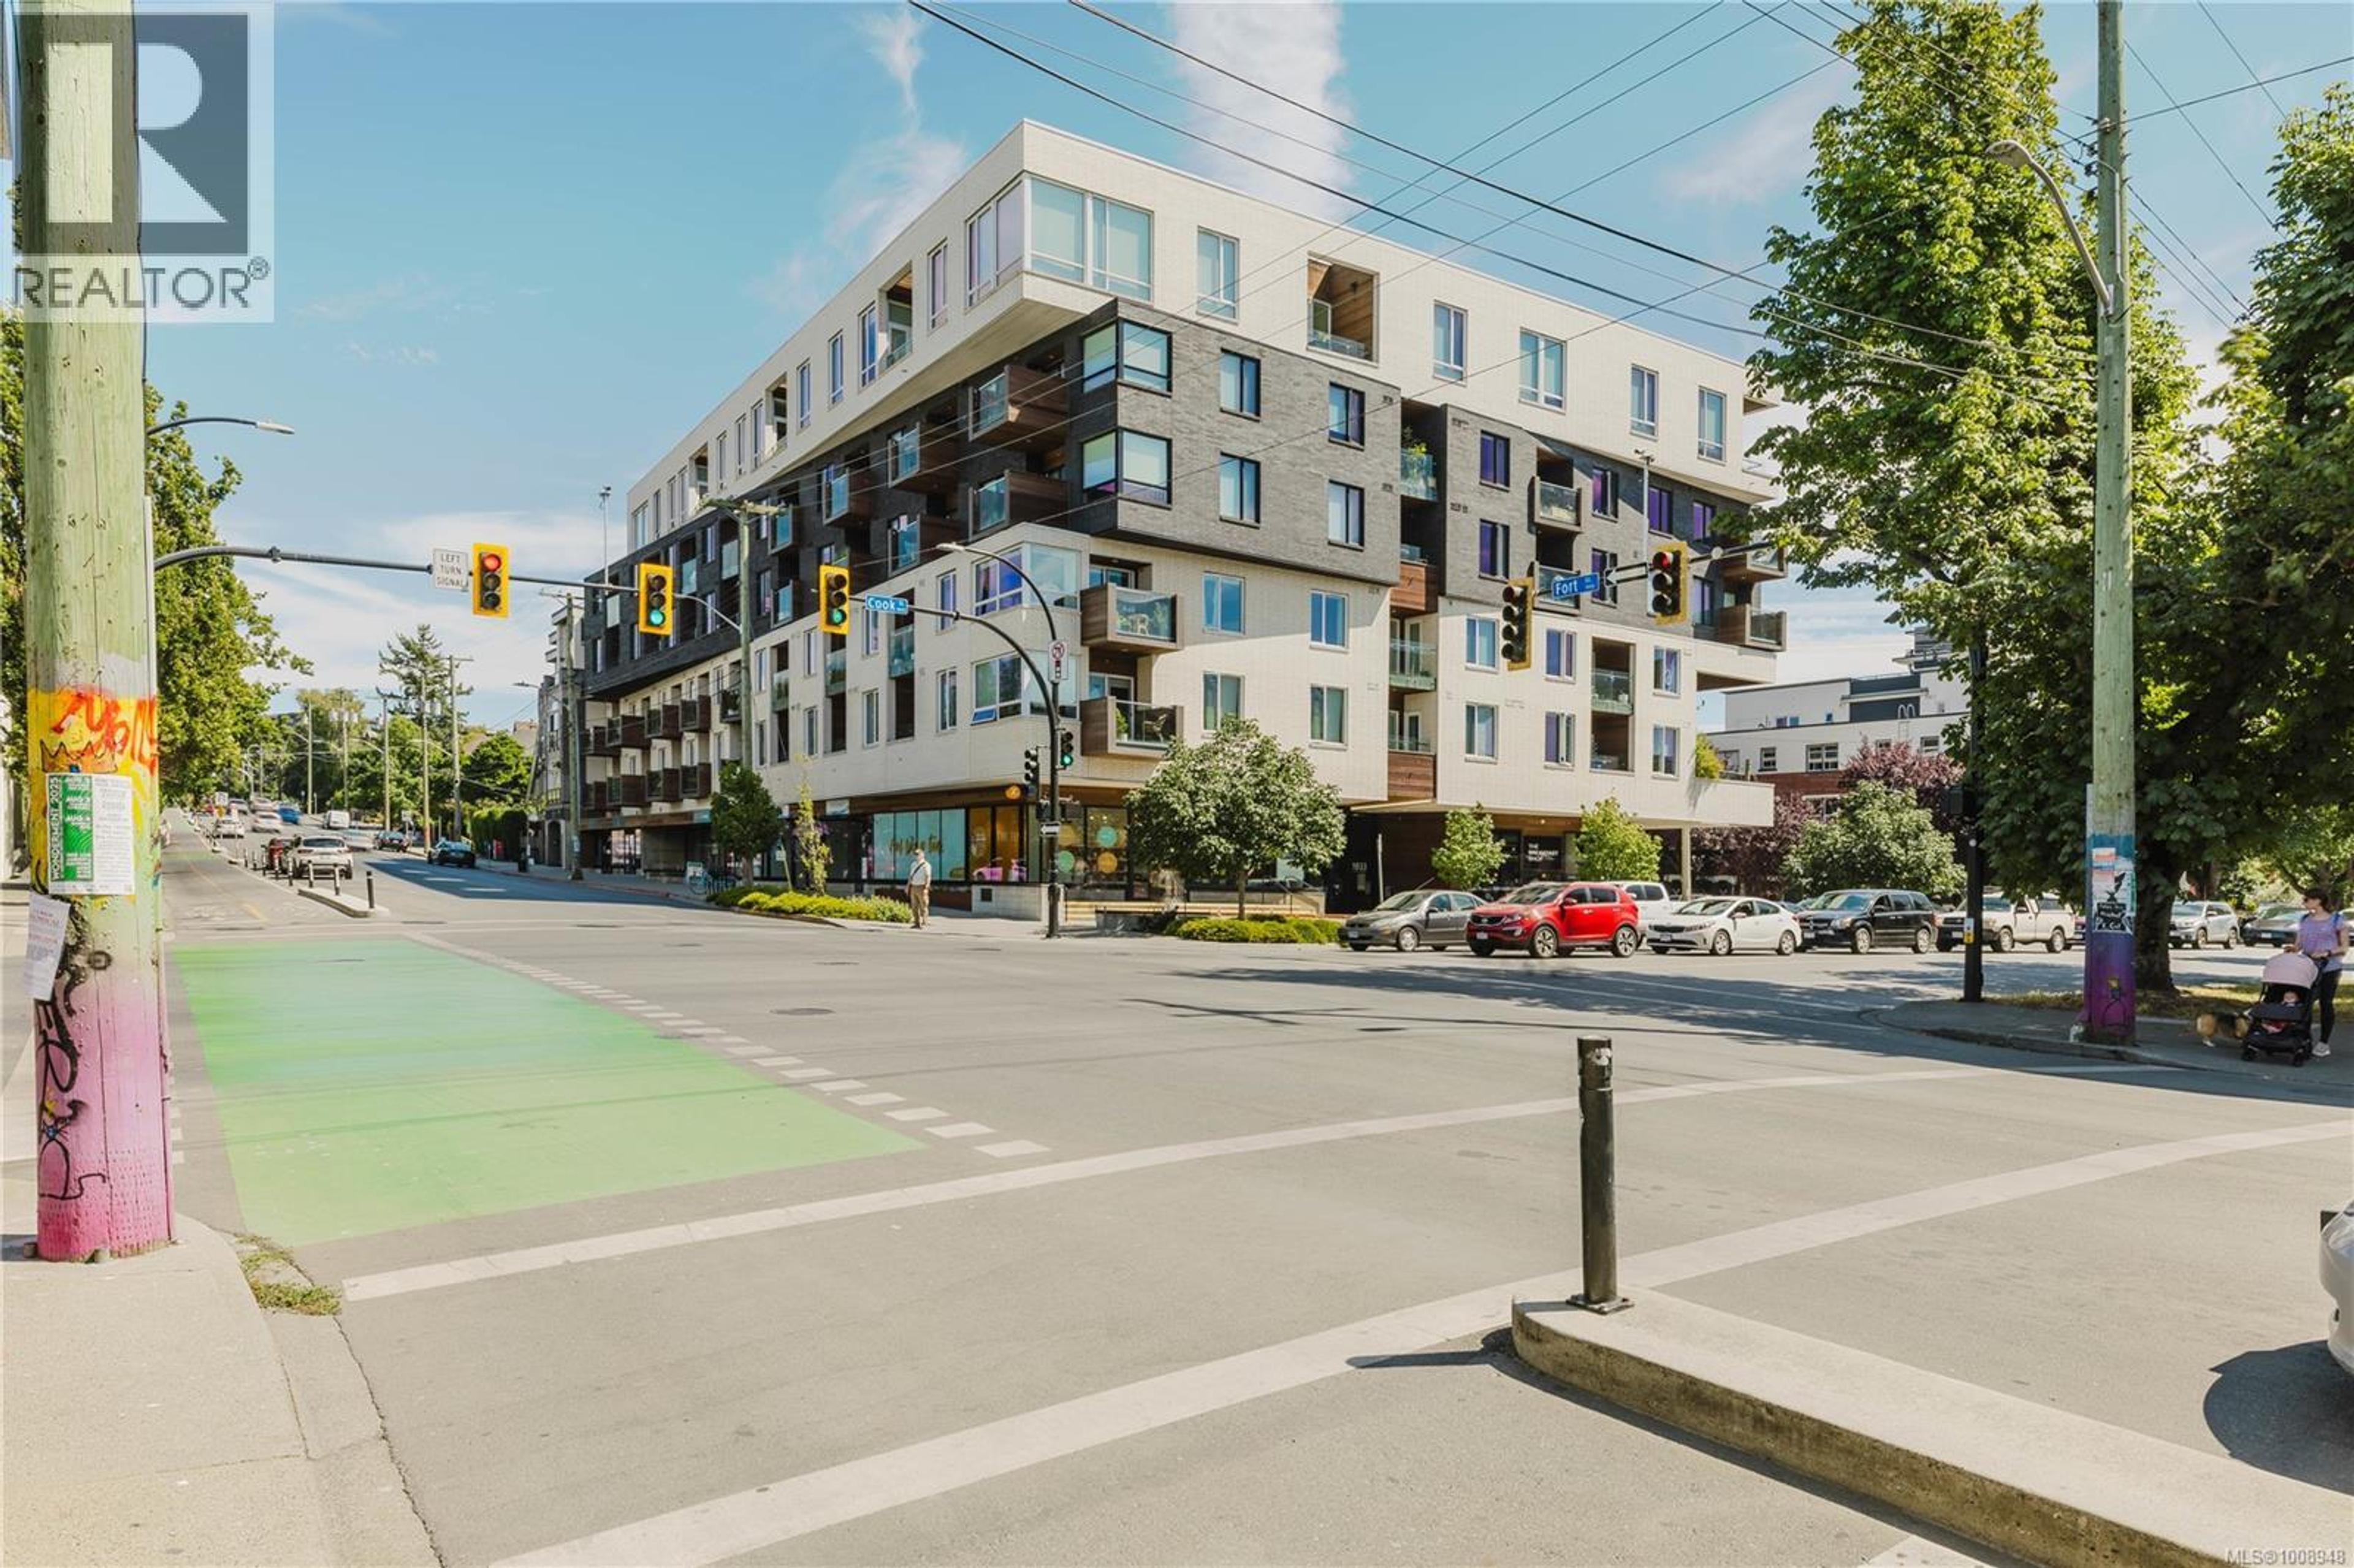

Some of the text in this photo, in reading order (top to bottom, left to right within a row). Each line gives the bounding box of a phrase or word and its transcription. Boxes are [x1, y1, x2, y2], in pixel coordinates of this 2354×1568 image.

[440, 553, 460, 563] LEFT
[440, 564, 462, 575] TURN
[436, 576, 467, 587] SIGNAL
[1555, 579, 1579, 596] Fort
[868, 597, 896, 611] Cook
[50, 776, 60, 880] WONDERMENT 2025
